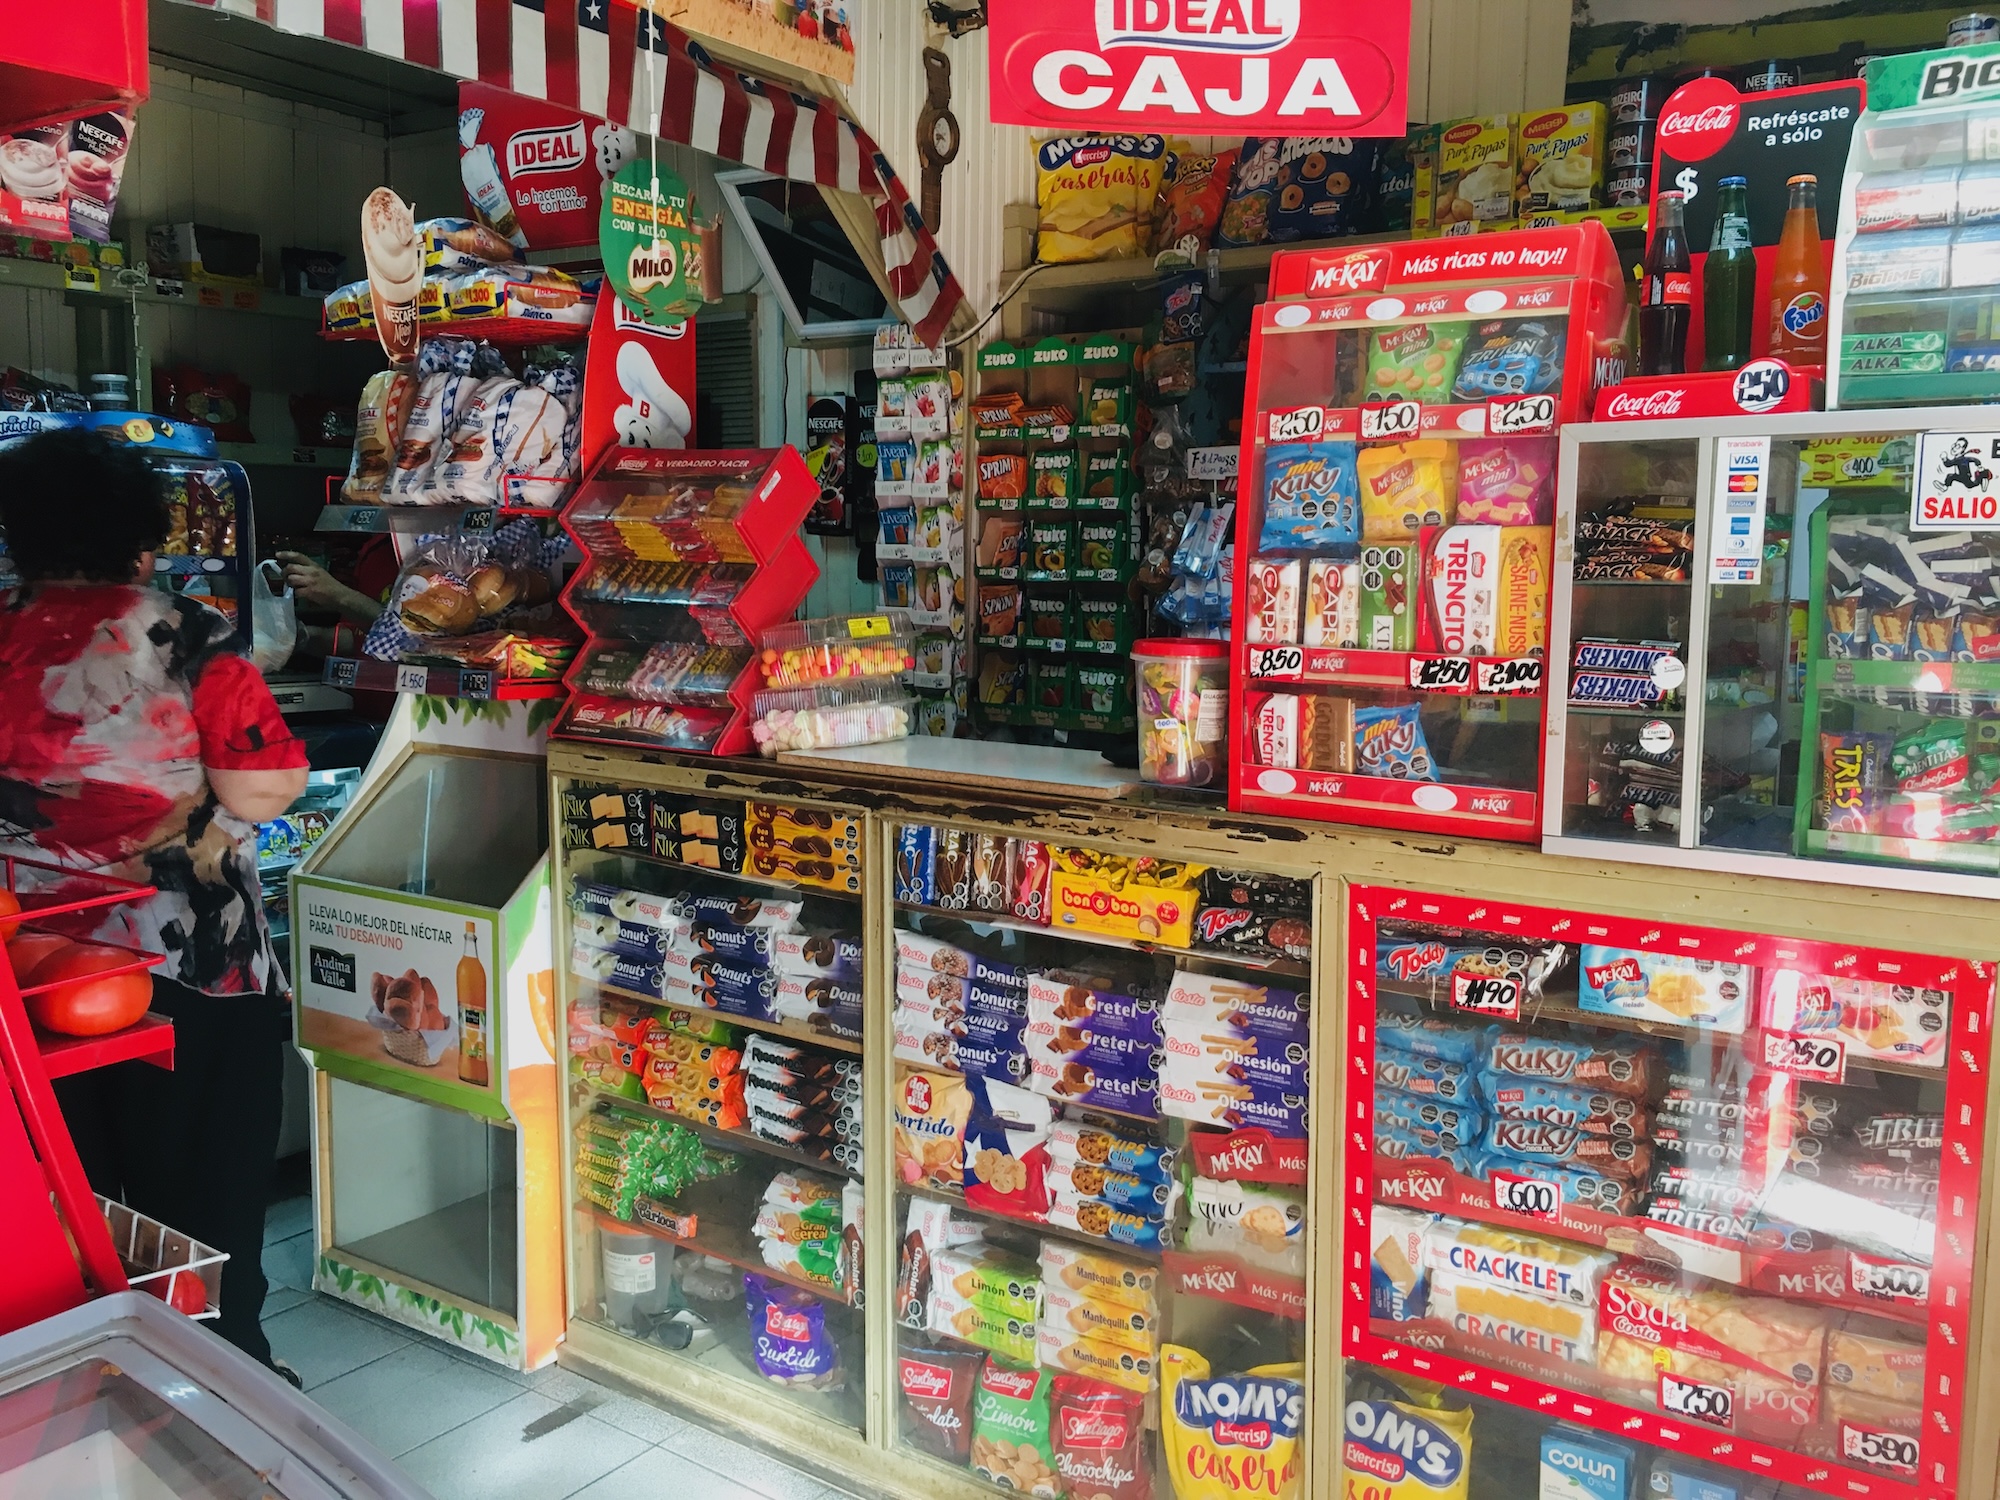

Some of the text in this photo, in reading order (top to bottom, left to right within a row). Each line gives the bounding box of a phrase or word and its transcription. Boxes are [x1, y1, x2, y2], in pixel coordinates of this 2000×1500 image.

[1113, 0, 1284, 35] IDEAL
[1032, 49, 1362, 116] CAJA
[1660, 103, 1737, 138] Coca-Cola
[1748, 106, 1850, 132] Refréscate
[1525, 139, 1552, 157] Puré
[1552, 132, 1589, 156] Papas
[1765, 126, 1823, 146] a sólo
[514, 134, 580, 166] IDEAL
[1471, 139, 1506, 161] Papas
[517, 186, 577, 206] Lo hacemos
[540, 196, 587, 214] con amor
[612, 182, 685, 208] RECARA TU
[611, 197, 686, 228] ENERGÍA
[612, 219, 633, 234] CON
[632, 258, 673, 278] MILO
[1403, 247, 1568, 277] Más ricas no hay!!
[1310, 257, 1378, 291] McKAY
[1083, 345, 1119, 360] ZUKO
[1401, 338, 1431, 356] mini
[1853, 336, 1902, 352] ALKA
[984, 354, 1016, 366] ZUKO
[1033, 349, 1068, 363] ZUKO
[1851, 356, 1900, 371] ALKA
[1607, 389, 1688, 418] Coca-Cola
[978, 408, 1011, 424] SPRIM
[878, 445, 909, 458] Livean
[1727, 440, 1763, 448] transbank
[655, 458, 750, 468] EL VERDADERO PLACER
[980, 458, 1011, 480] SPRIM
[1035, 456, 1071, 470] ZUKO
[1286, 458, 1329, 478] mini
[1734, 455, 1758, 465] VISA
[1480, 472, 1511, 488] mini
[1924, 497, 1997, 519] SALIO
[1443, 538, 1470, 654] TRENCITO
[1576, 675, 1662, 701] SNICKERS
[1363, 716, 1401, 741] mini
[1904, 747, 1960, 777] MENTITAS
[1834, 745, 1863, 809] TRES
[1062, 887, 1092, 909] bon
[1110, 896, 1140, 919] bon
[308, 904, 453, 944] LLEVA LO MEJOR DEL NÉCTAR
[309, 920, 403, 951] PARA TU DESAYUNO
[1200, 908, 1250, 940] Toddy
[1234, 928, 1263, 941] BLACK
[708, 928, 747, 945] Donuts
[313, 952, 351, 974] Andina
[1389, 941, 1445, 981] Toddy
[711, 962, 752, 985] Donuts
[1592, 963, 1636, 986] McKAY
[970, 988, 1019, 1011] Donuts
[1085, 996, 1137, 1020] Gretel
[1172, 989, 1206, 1006] Costa
[1228, 997, 1298, 1022] Obsesión
[949, 1042, 997, 1063] Donuts
[1080, 1030, 1135, 1054] Gretel
[1166, 1037, 1200, 1056] Costa
[1221, 1048, 1292, 1075] Obsesión
[910, 1076, 930, 1092] dos
[914, 1089, 925, 1100] en
[1084, 1070, 1137, 1096] Gretel
[1161, 1084, 1197, 1103] Costa
[909, 1097, 930, 1111] uno
[1218, 1093, 1289, 1120] Obsesión
[1097, 1135, 1146, 1156] CHIPS
[1109, 1150, 1136, 1165] Choc
[1211, 1143, 1306, 1174] McKAY Más
[1381, 1177, 1446, 1201] McKAY
[1460, 1192, 1491, 1210] Más
[637, 1202, 676, 1231] Carioca
[801, 1220, 827, 1233] Gran
[1096, 1208, 1145, 1230] CHIPS
[1648, 1206, 1756, 1239] TRITON
[791, 1227, 828, 1241] Cereal
[1110, 1223, 1137, 1239] Choc
[850, 1240, 860, 1289] Chocolate
[908, 1246, 924, 1298] Chocolate
[1449, 1247, 1572, 1294] CRACKELET
[970, 1278, 1006, 1298] Limón
[1075, 1266, 1122, 1288] Mantequilla
[1182, 1269, 1279, 1300] McKAY Más
[1081, 1309, 1130, 1331] Mantequilla
[1606, 1286, 1690, 1333] Soda
[970, 1313, 1005, 1334] Limón
[1613, 1319, 1662, 1343] Costa
[1454, 1313, 1577, 1361] CRACKELET
[1073, 1348, 1120, 1371] Mantequilla
[903, 1366, 948, 1391] Santiago
[982, 1362, 1033, 1392] Santiago
[976, 1391, 1038, 1433] Limón
[1064, 1416, 1123, 1444] Santiago
[1055, 1453, 1135, 1488] Chocochips
[1346, 1444, 1401, 1476] Evercrisp
[1548, 1449, 1616, 1481] COLUN
